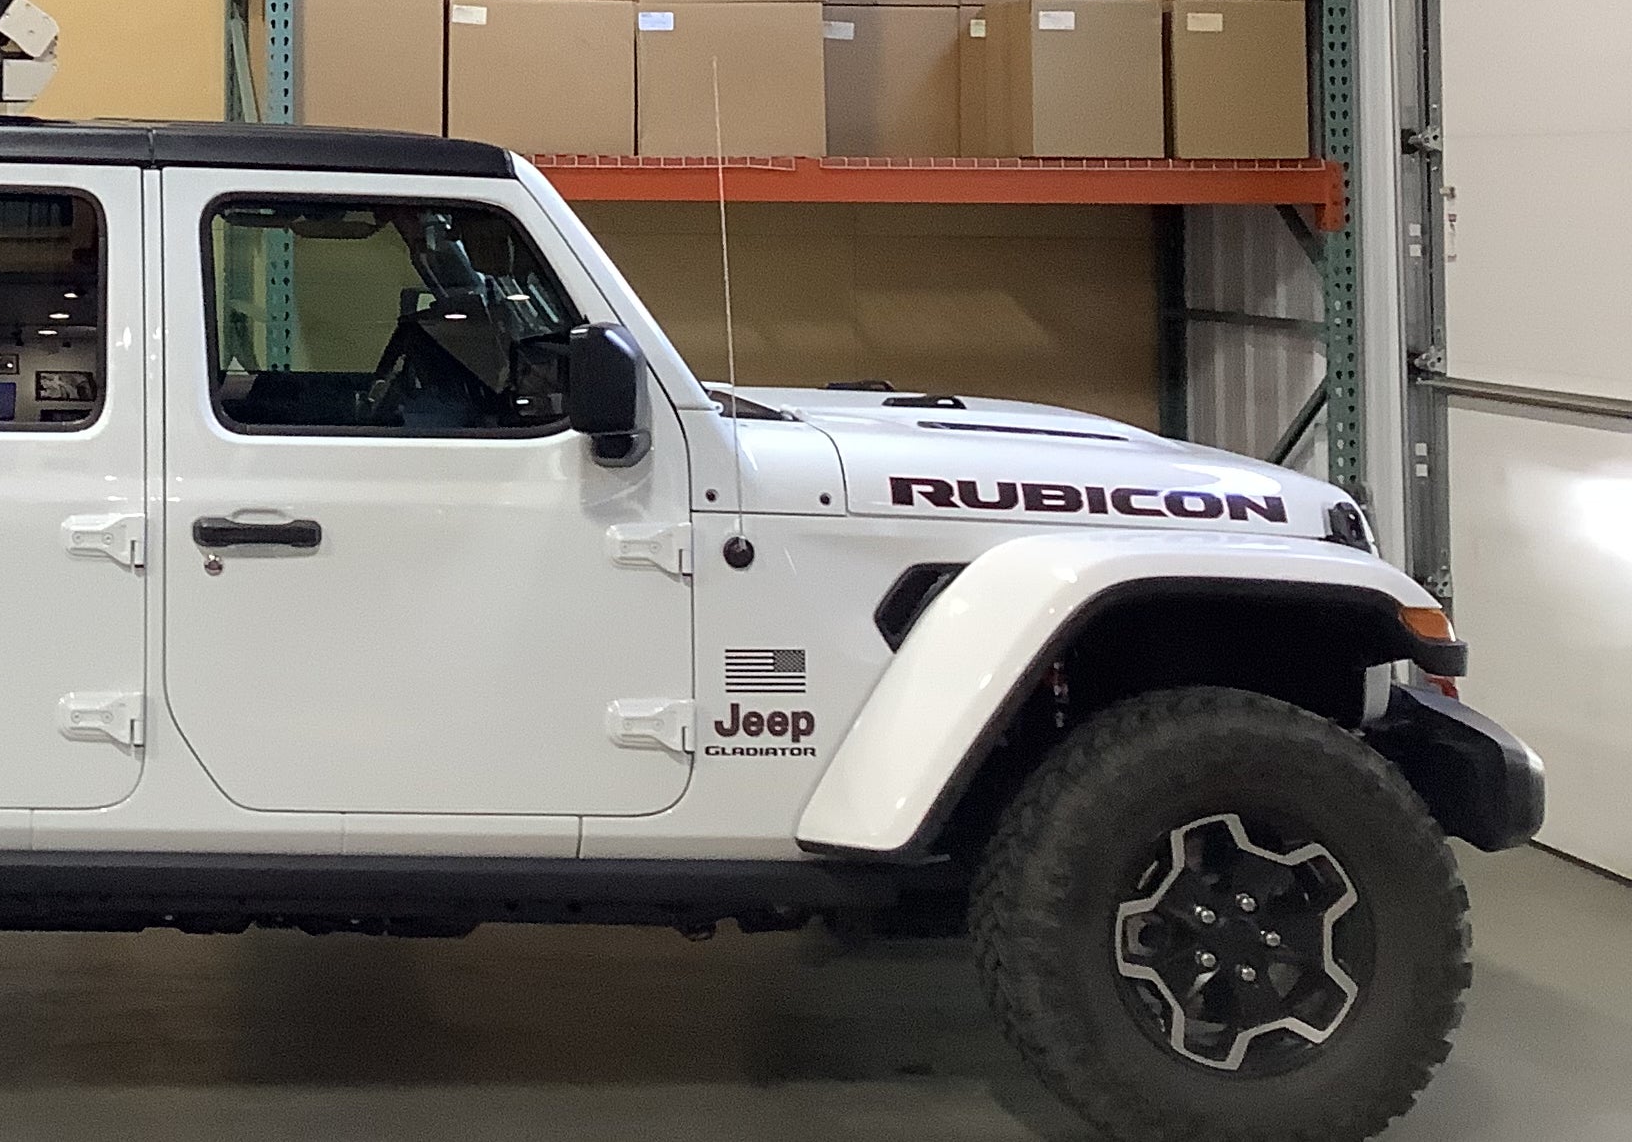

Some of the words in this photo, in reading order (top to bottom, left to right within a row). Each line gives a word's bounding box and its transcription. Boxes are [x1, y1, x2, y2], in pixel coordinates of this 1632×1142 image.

[890, 477, 1288, 523] RUBICON
[714, 703, 816, 743] Jeep
[705, 745, 816, 757] GLADIATOR
